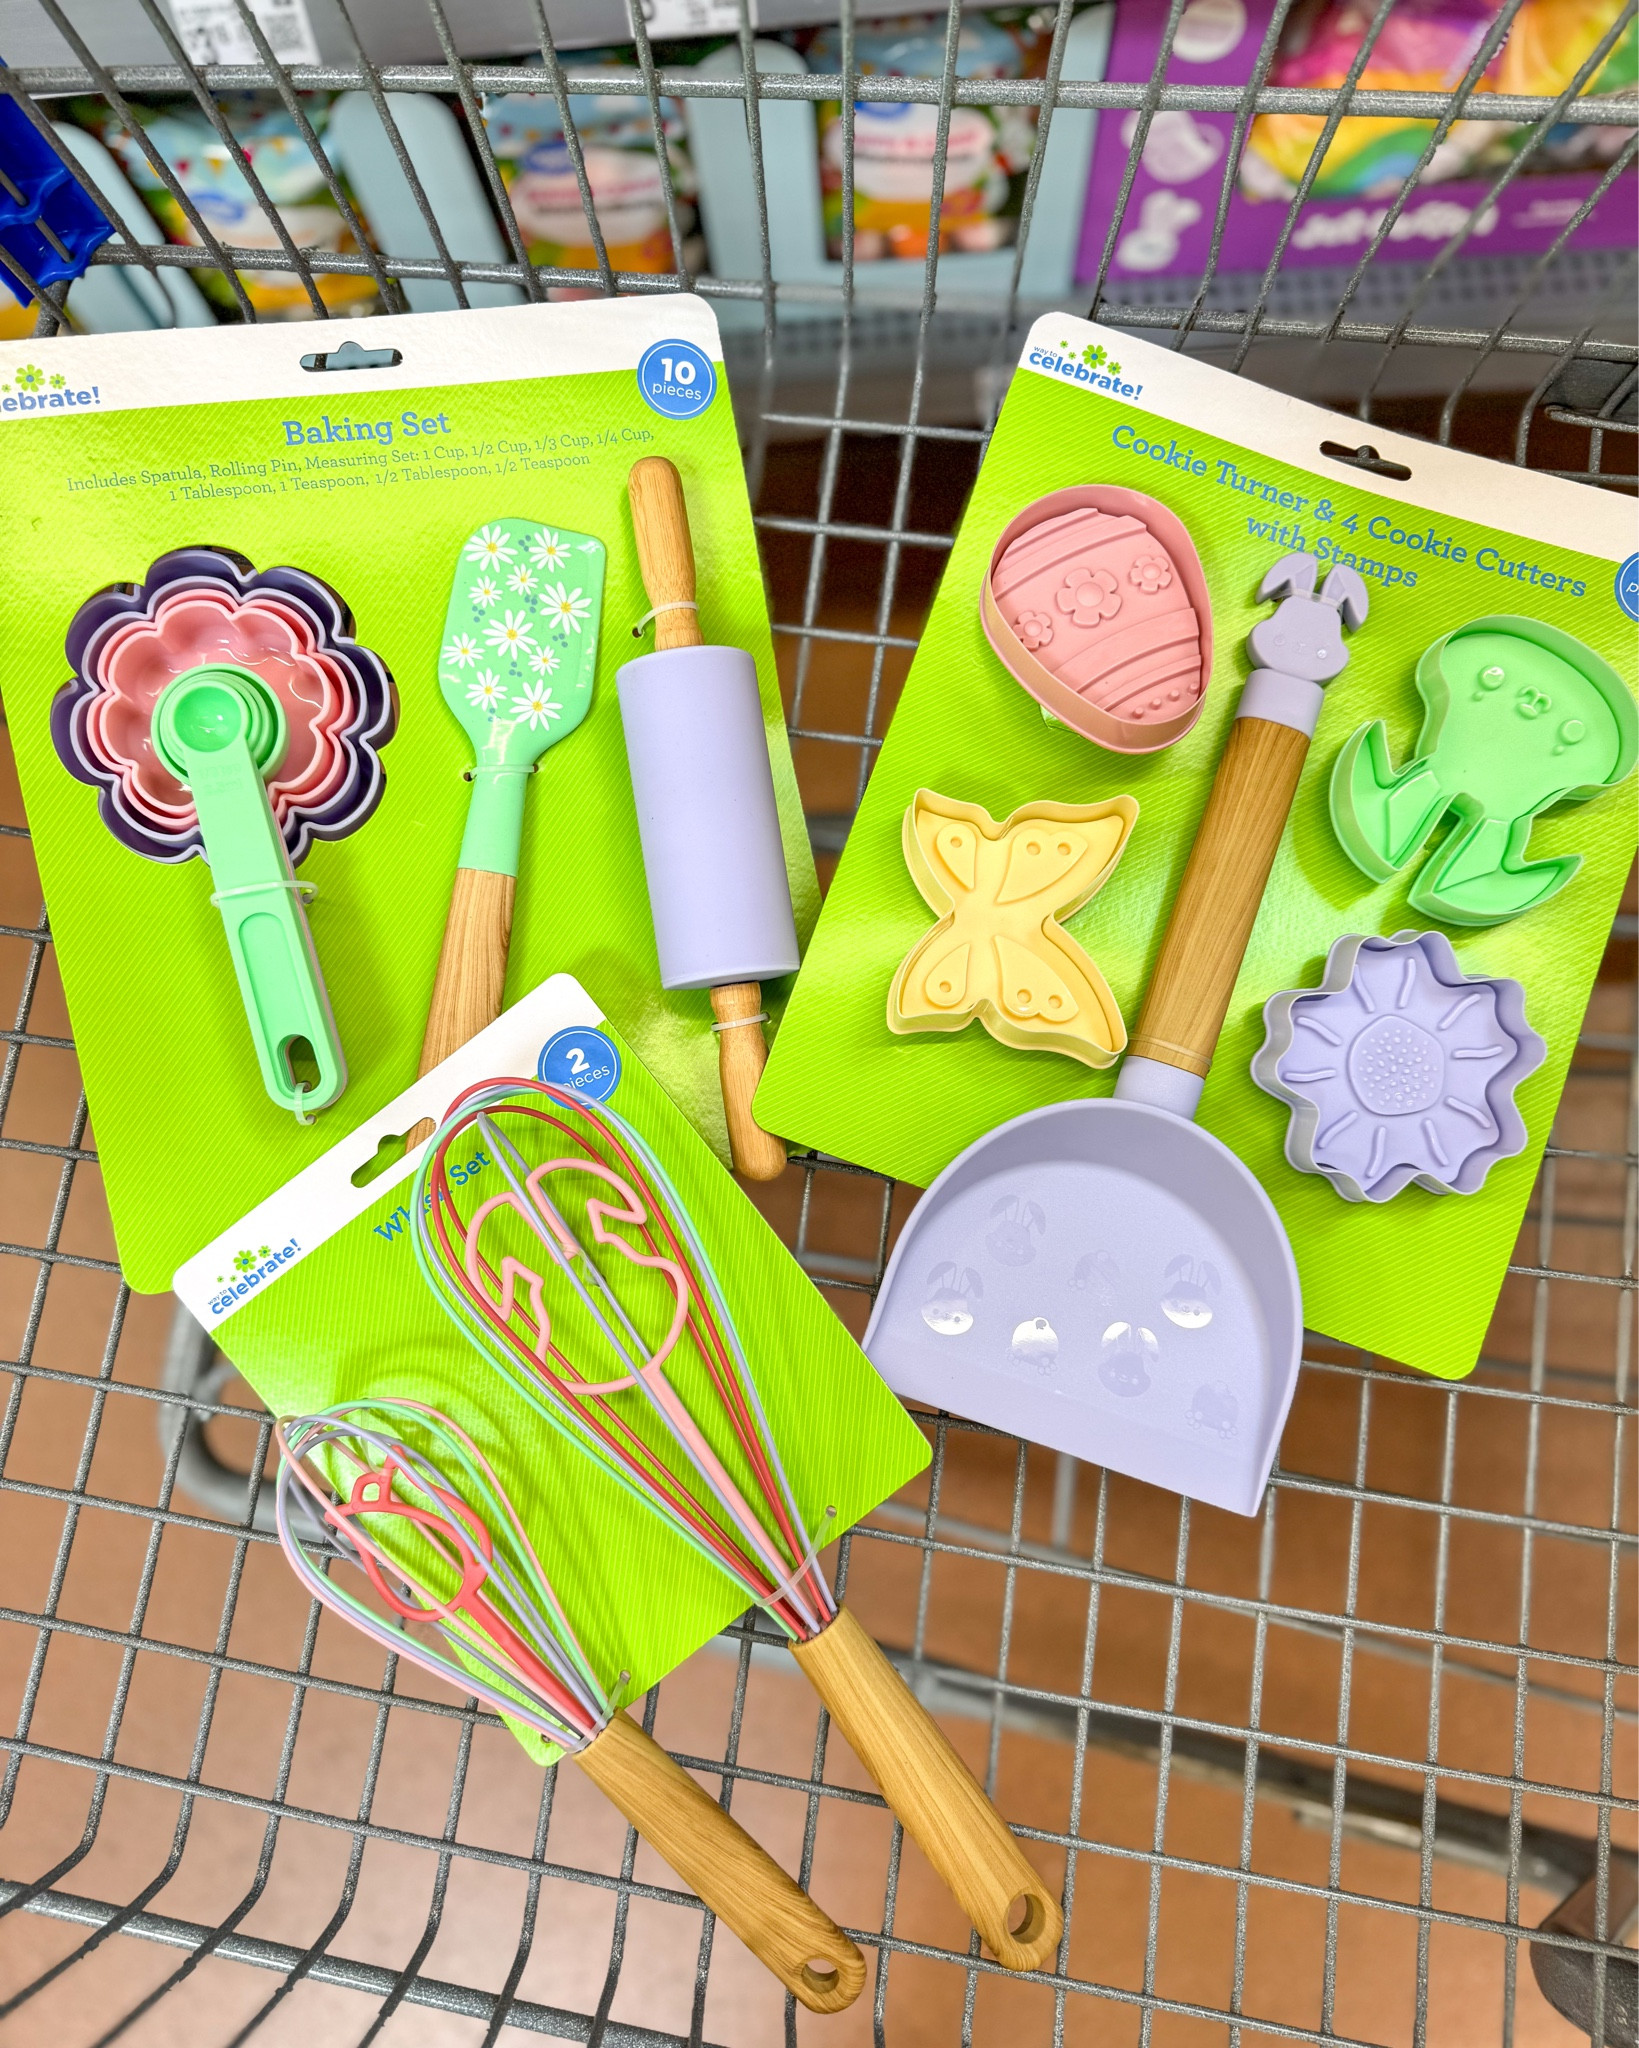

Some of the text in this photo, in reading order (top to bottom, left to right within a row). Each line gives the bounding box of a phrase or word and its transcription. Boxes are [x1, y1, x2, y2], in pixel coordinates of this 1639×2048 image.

[1034, 345, 1058, 358] way to
[661, 358, 696, 385] 10
[1029, 352, 1143, 400] celebrate!
[0, 386, 101, 412] ebrate!
[652, 382, 702, 400] pieces
[282, 411, 451, 446] Baking Set
[67, 428, 655, 491] Includes Spatula, Rolling Pin, Measuring Set: 1 Cup, 1/2 Cup, 1/3 Cup, 1/4 Cup,
[169, 455, 591, 501] 1 Tablespoon, 1 Teaspoon, 1/2 Tablespoon, 1/2 Teaspoon
[1112, 425, 1587, 597] Cookie Turner & 4 Cookie Cutters
[1247, 517, 1418, 587] with Stamps
[566, 1048, 590, 1075] 2
[449, 1151, 491, 1185] Set
[211, 1238, 301, 1314] celebrate!
